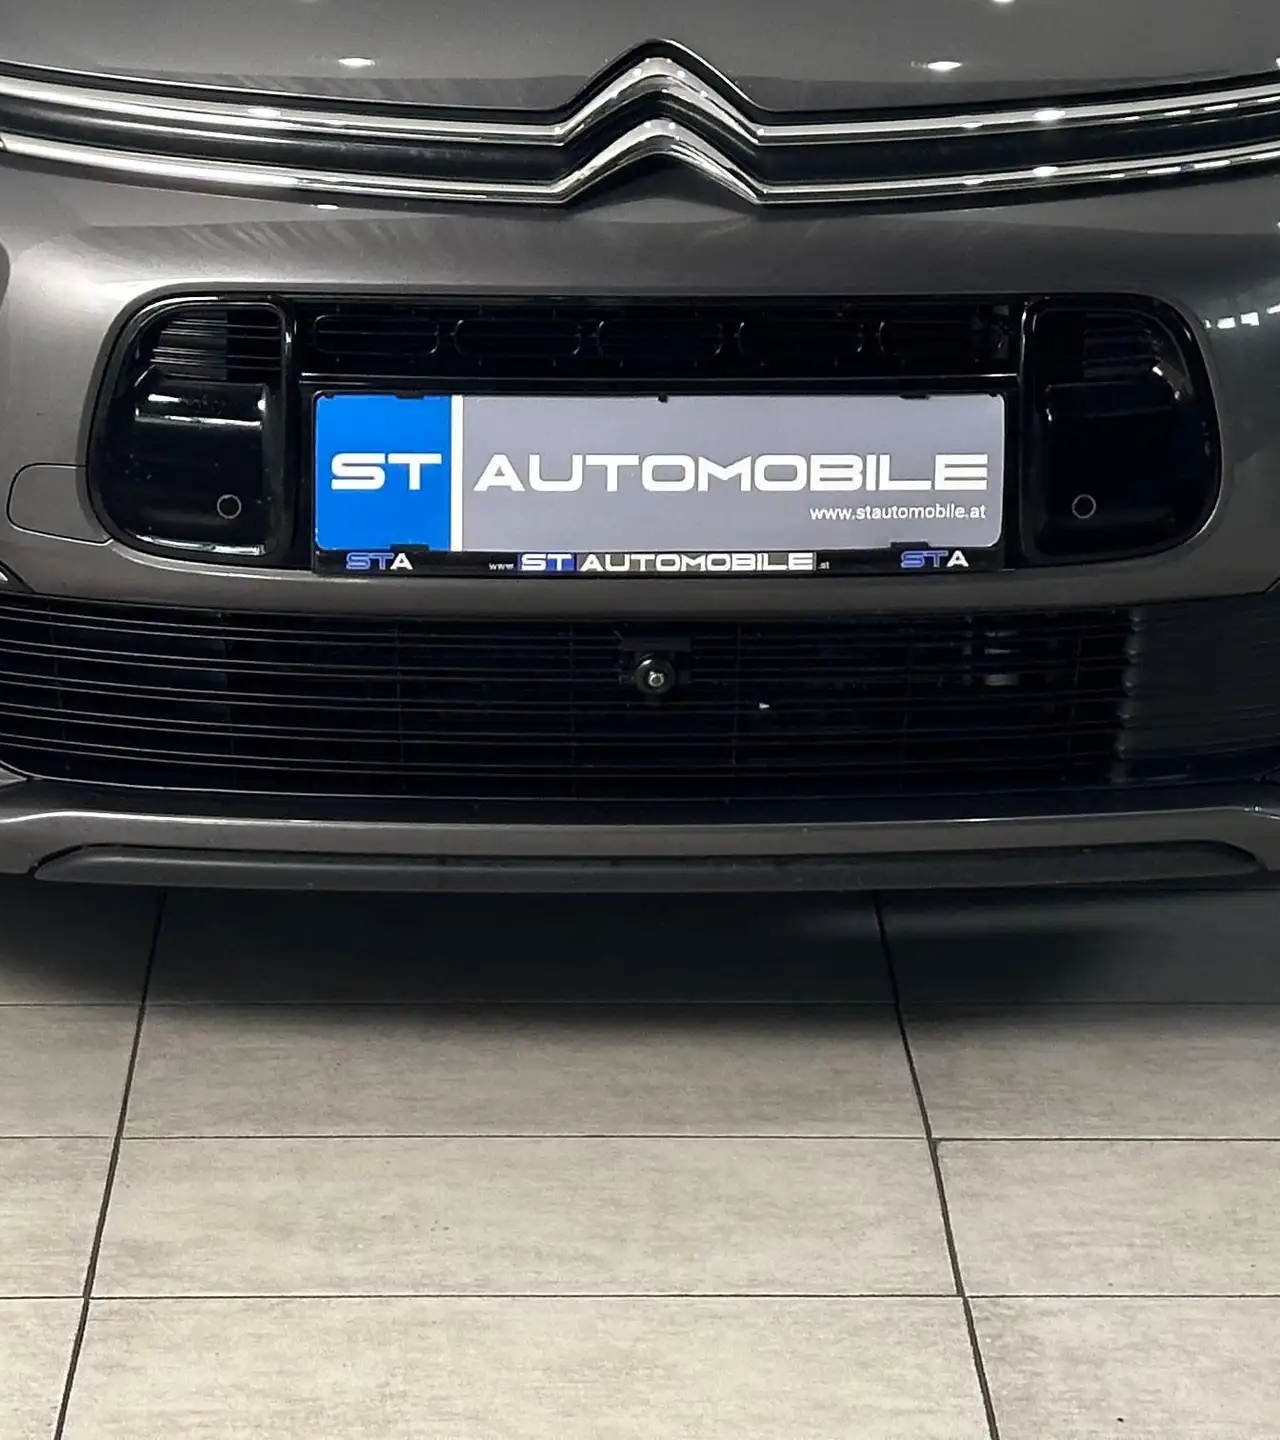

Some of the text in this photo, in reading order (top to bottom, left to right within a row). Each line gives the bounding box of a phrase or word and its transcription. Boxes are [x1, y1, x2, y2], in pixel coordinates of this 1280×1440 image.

[331, 453, 988, 492] ST AUTOMOBILE
[809, 503, 986, 520] www.stautomobile.at
